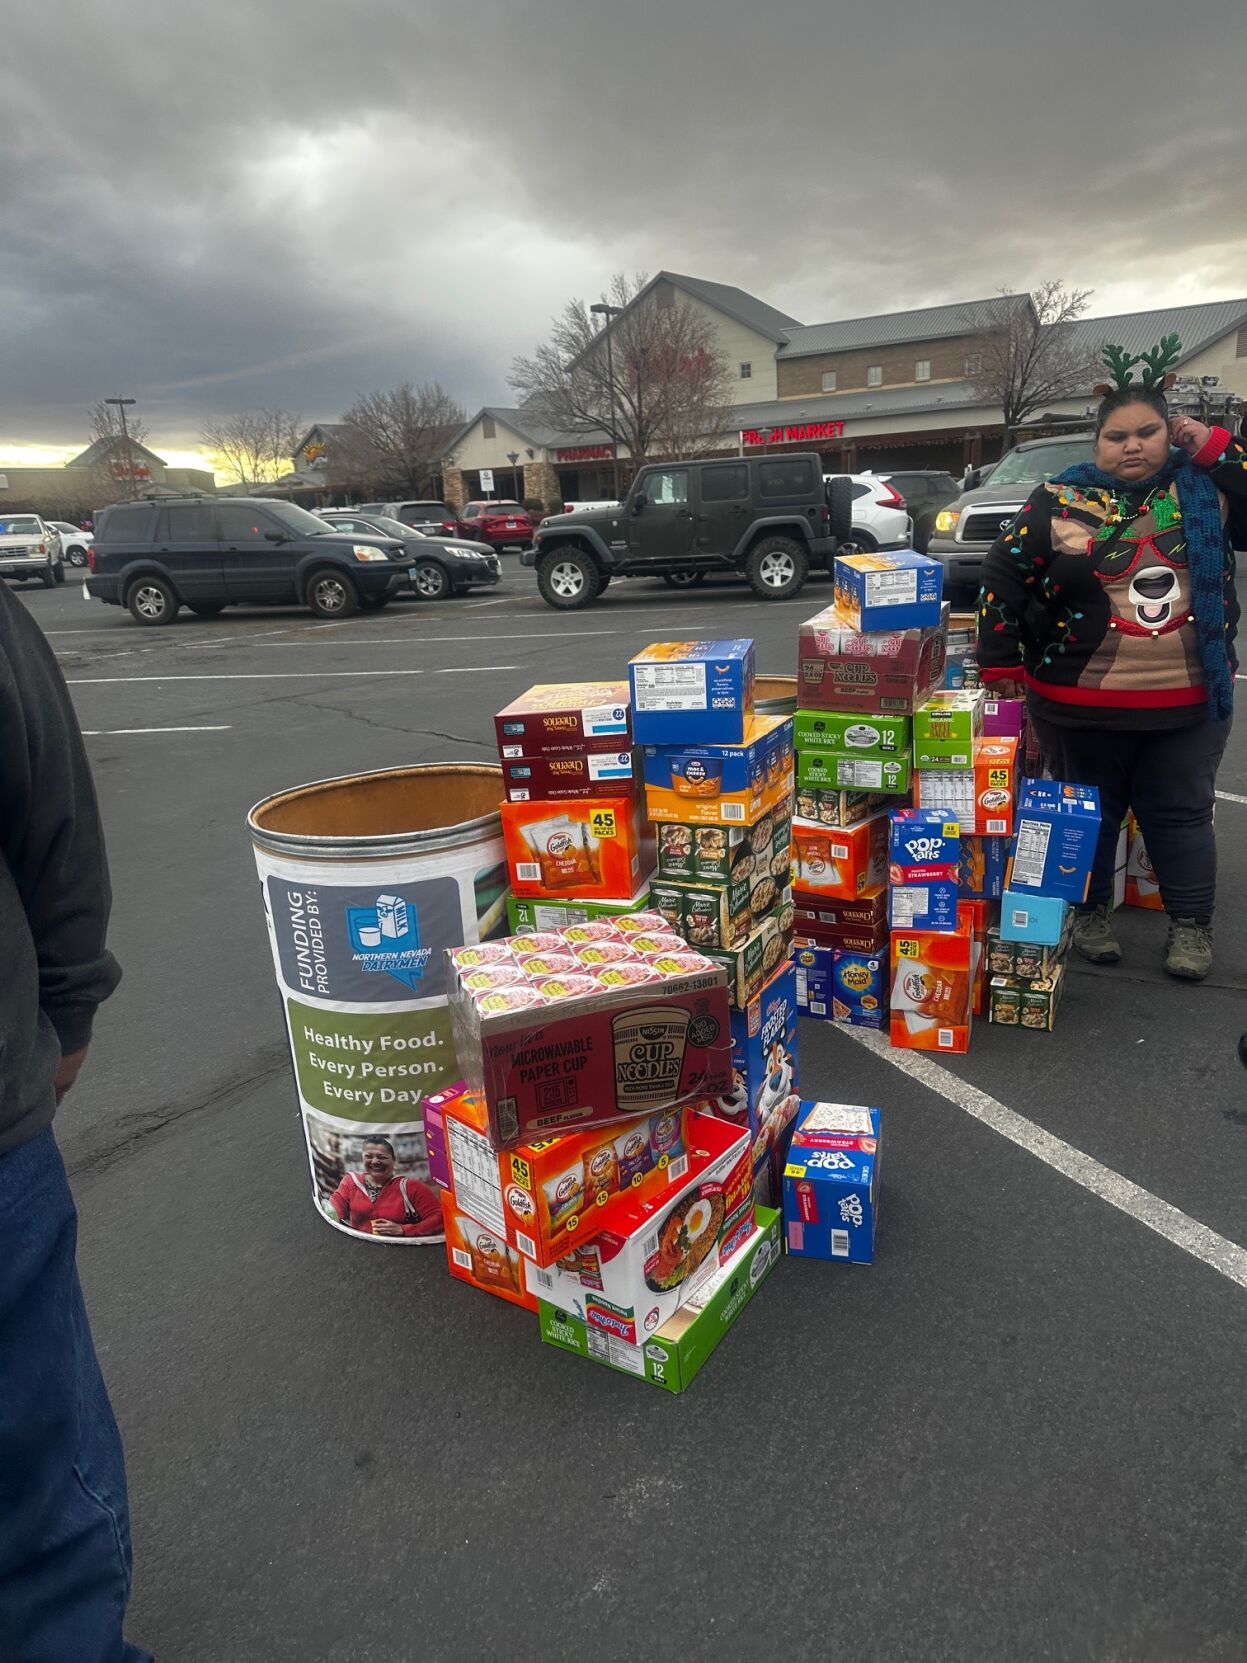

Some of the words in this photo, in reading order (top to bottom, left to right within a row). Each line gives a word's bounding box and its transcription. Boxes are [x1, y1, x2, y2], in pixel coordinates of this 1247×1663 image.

[786, 420, 845, 441] MARKET
[835, 672, 875, 682] NOODLES
[543, 716, 578, 727] Cheerios
[882, 730, 895, 745] 12
[549, 760, 583, 771] Cheerios
[888, 775, 896, 785] 12
[990, 770, 1007, 780] 45
[984, 794, 1007, 806] Goldfish
[594, 814, 613, 826] 45
[550, 838, 572, 851] Goldfish
[306, 890, 320, 913] BY:
[397, 902, 408, 933] MILK
[519, 910, 528, 922] 12
[843, 910, 870, 920] Cheerios
[288, 892, 315, 990] FUNDING
[843, 938, 871, 948] Cheerios
[900, 941, 909, 955] 45
[311, 917, 330, 994] PROVIDED
[352, 952, 398, 961] NORTHERN
[400, 948, 432, 959] NEVADA
[362, 956, 429, 972] DAIRYMEN
[662, 976, 719, 995] 70662-13801
[912, 974, 922, 998] Goldfish
[761, 999, 787, 1040] FROSTED
[642, 1027, 664, 1035] NISSIN
[763, 1016, 784, 1049] FLAKES
[304, 1026, 373, 1055] Healthy
[380, 1030, 444, 1051] Food.
[512, 1036, 592, 1068] MICROWAVABLE
[631, 1043, 673, 1062] CUP
[309, 1052, 356, 1079] Every
[362, 1060, 444, 1078] Person.
[520, 1062, 560, 1083] PAPER
[564, 1056, 587, 1073] CUP
[617, 1059, 680, 1082] NOODLES
[323, 1080, 374, 1106] Every
[380, 1088, 429, 1105] Day.
[537, 1115, 562, 1126] BEEF
[564, 1112, 583, 1120] FLAVOR
[512, 1158, 528, 1177] 45
[633, 1175, 642, 1183] 10
[510, 1196, 531, 1209] Goldfish
[597, 1194, 606, 1203] 15
[568, 1218, 577, 1228] 15
[772, 1225, 777, 1238] 12
[480, 1241, 496, 1250] Goldfish
[550, 1320, 574, 1333] COOKED
[591, 1310, 629, 1336] Indomie
[546, 1330, 566, 1344] WHITE
[567, 1340, 581, 1348] RICE
[551, 1326, 573, 1338] STICKY
[652, 1363, 664, 1378] 12
